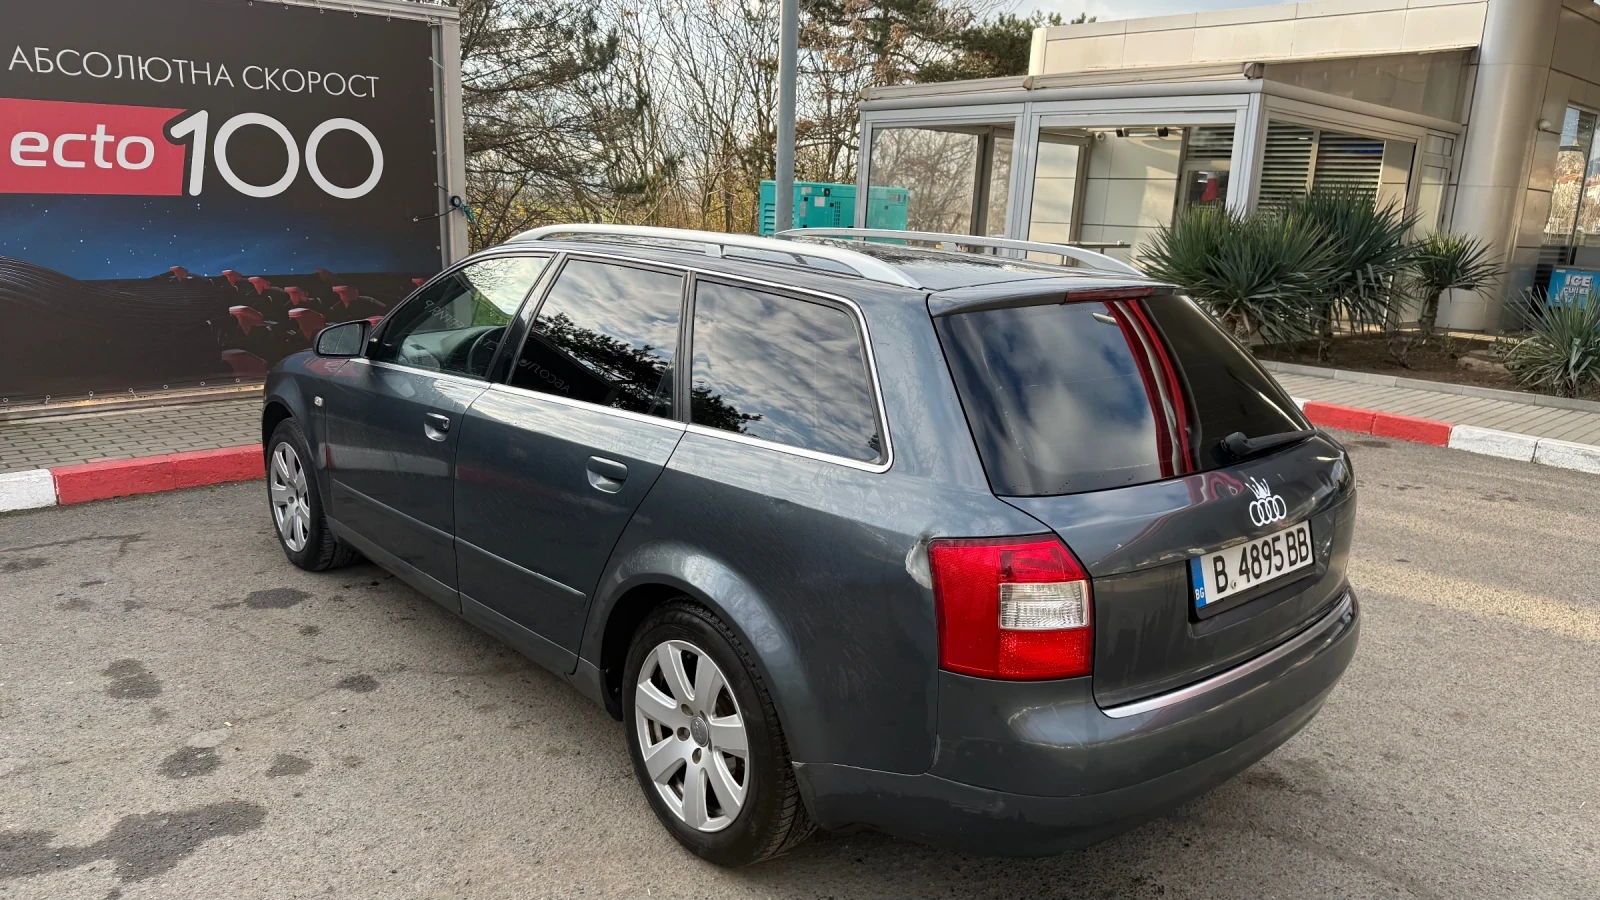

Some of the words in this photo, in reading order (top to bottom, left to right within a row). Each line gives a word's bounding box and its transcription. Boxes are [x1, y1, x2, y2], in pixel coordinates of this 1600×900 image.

[8, 45, 235, 88] АБСОЛЮТНА
[242, 65, 380, 98] СКОРОСТ
[10, 124, 155, 170] ecto
[170, 109, 384, 199] 100
[1565, 275, 1592, 287] ICE
[1213, 555, 1228, 594] B
[1238, 535, 1284, 583] 4895
[1286, 527, 1309, 567] BB
[1195, 587, 1205, 600] BG
